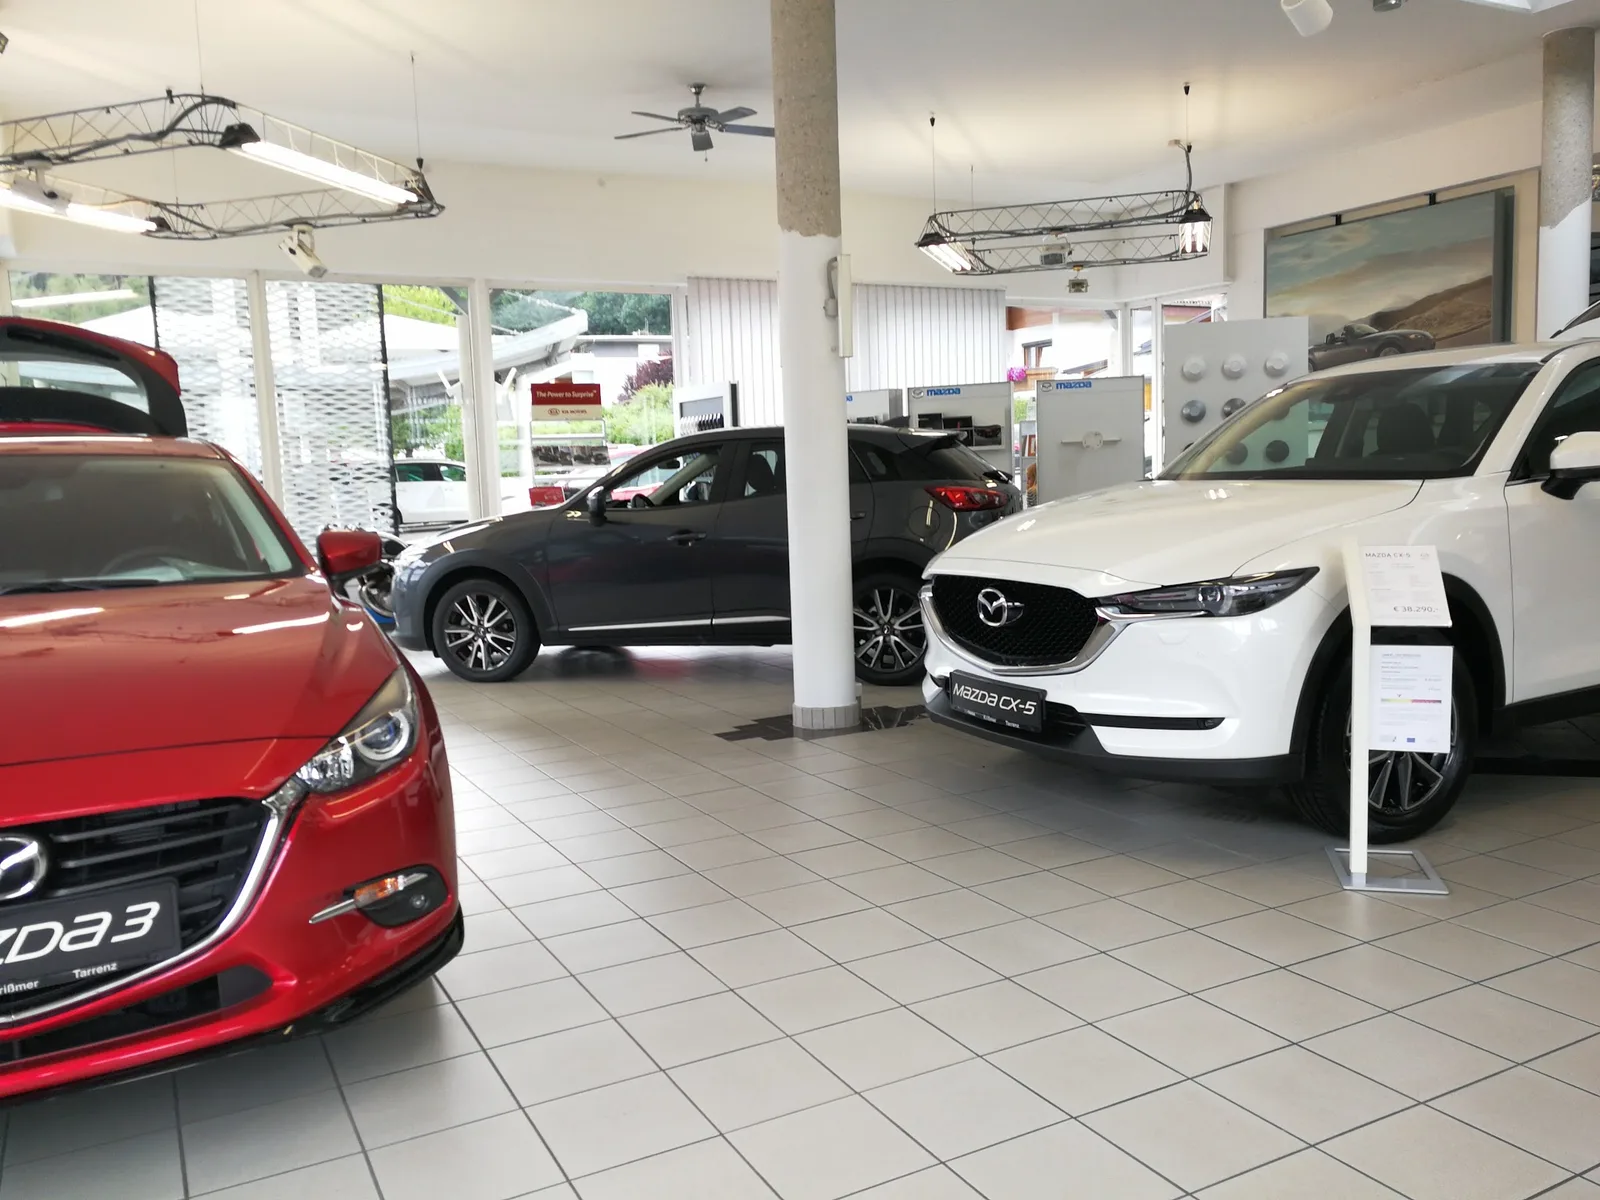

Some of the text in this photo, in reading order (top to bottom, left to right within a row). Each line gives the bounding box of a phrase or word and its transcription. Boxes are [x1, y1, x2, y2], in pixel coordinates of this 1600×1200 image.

[999, 696, 1037, 715] CX-5
[110, 901, 161, 944] 3
[0, 962, 118, 995] rißmer Tarrenz
